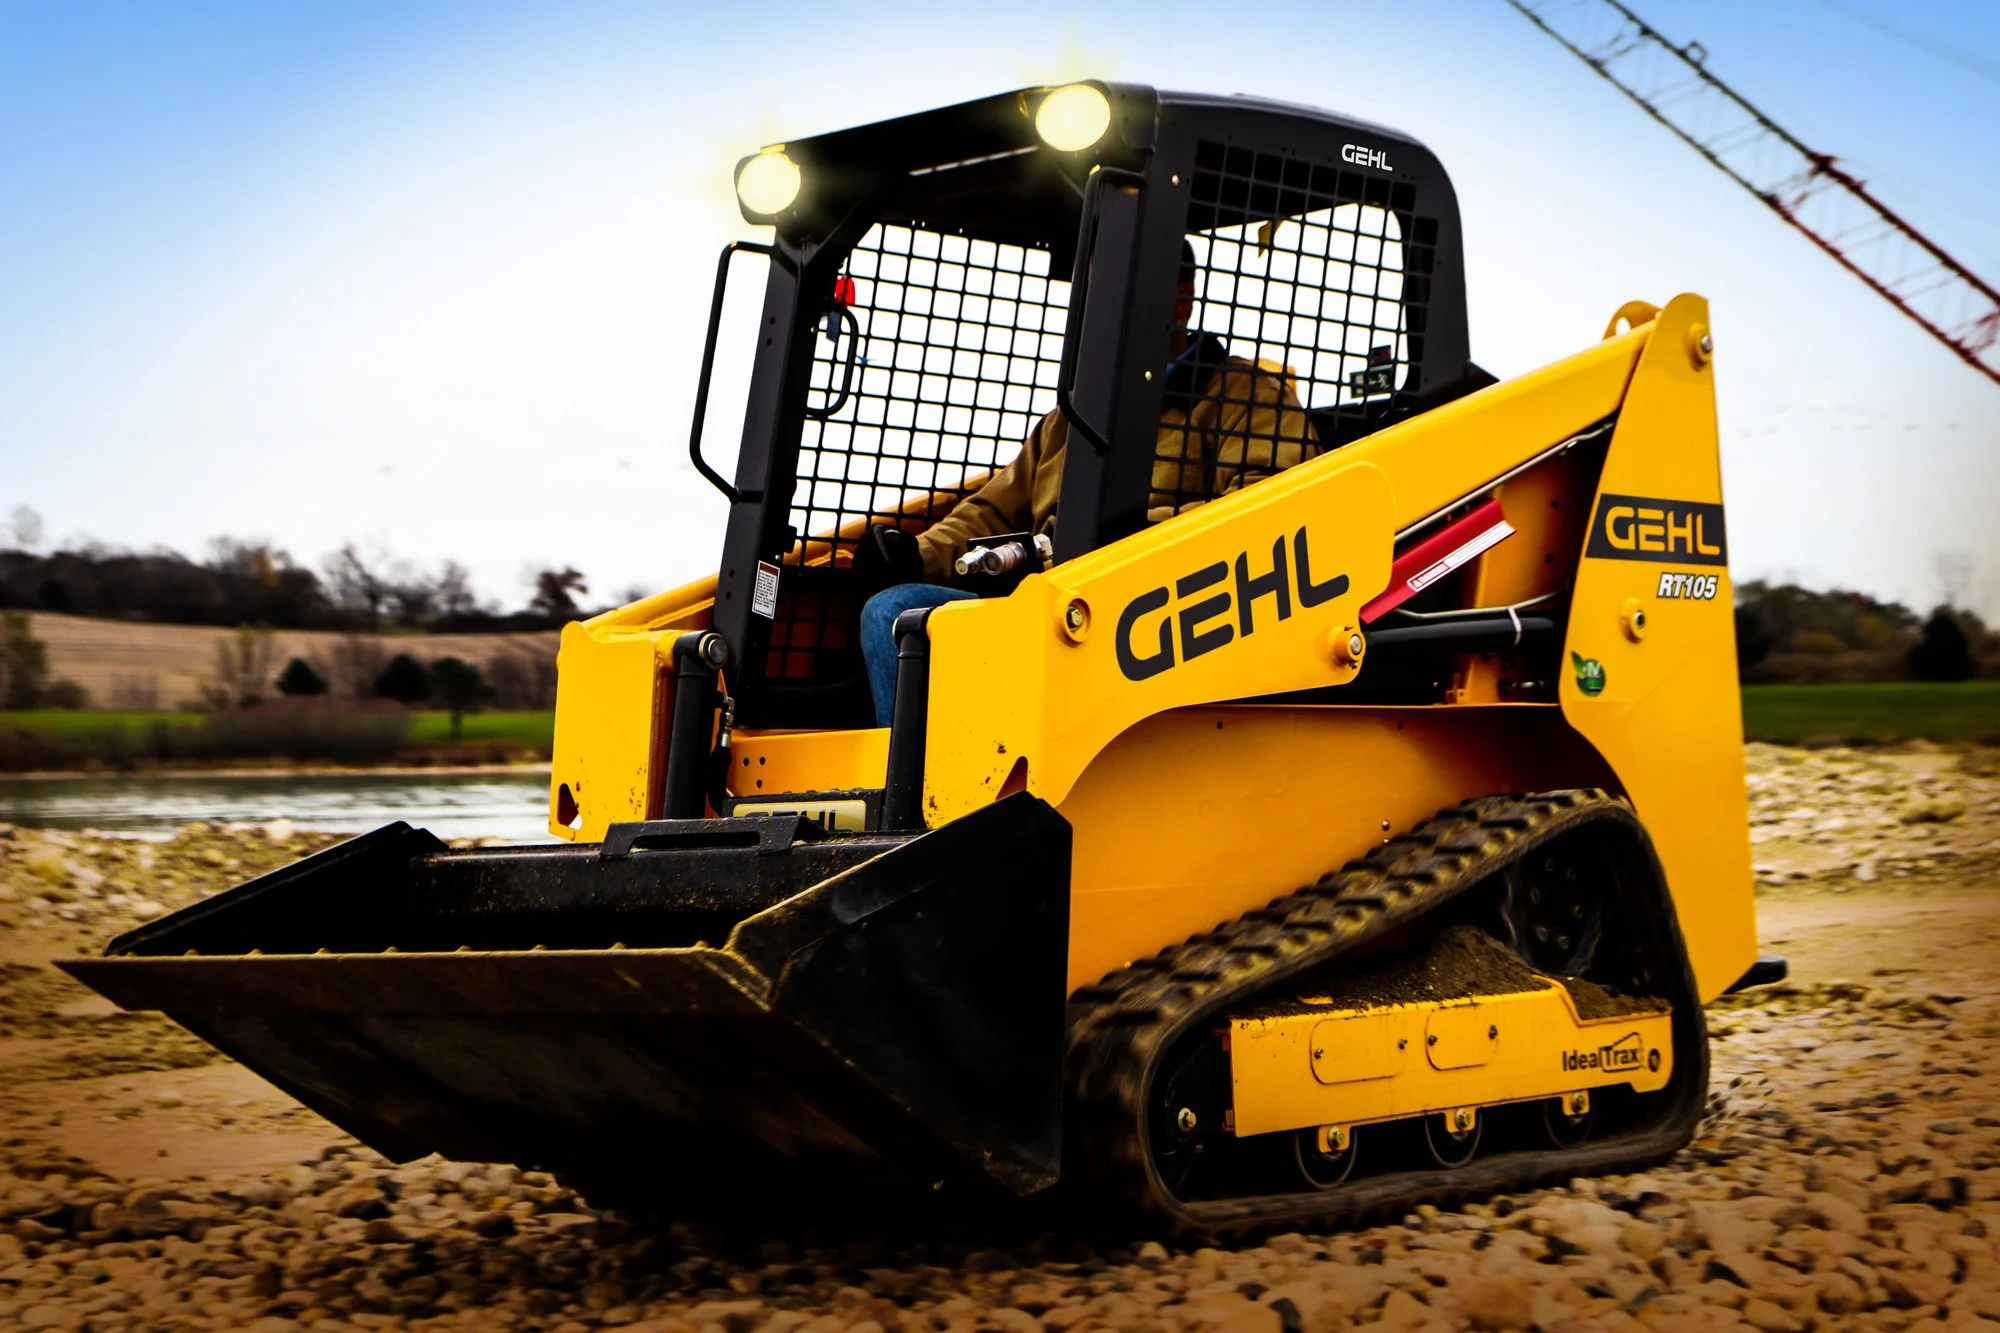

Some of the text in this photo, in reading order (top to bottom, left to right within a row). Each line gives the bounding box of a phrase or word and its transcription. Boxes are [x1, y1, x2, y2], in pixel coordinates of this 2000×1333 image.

[1341, 143, 1393, 172] GEHL
[1605, 506, 1720, 556] GEHL
[1115, 525, 1350, 681] GEHL
[1656, 572, 1719, 601] RT105
